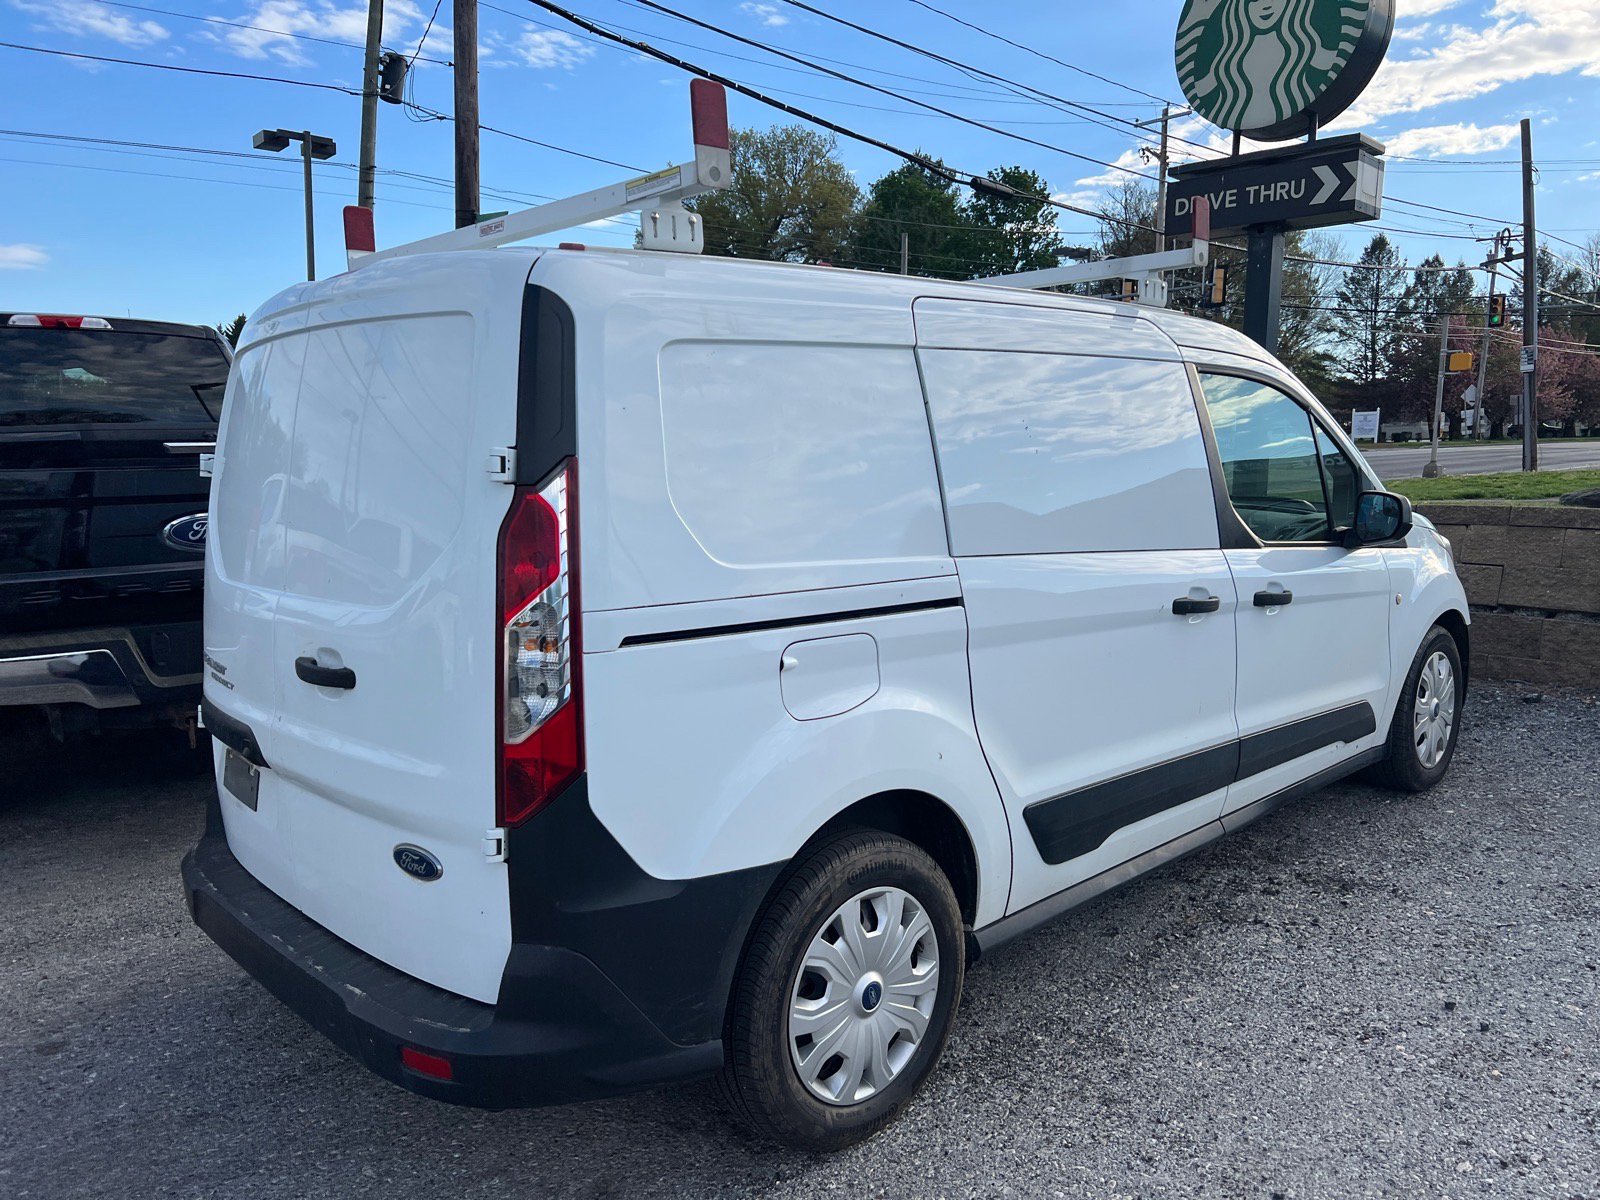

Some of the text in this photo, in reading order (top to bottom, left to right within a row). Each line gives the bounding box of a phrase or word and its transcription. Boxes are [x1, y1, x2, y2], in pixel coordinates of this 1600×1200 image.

[1174, 178, 1306, 217] DVE THRU
[400, 851, 427, 875] Ford
